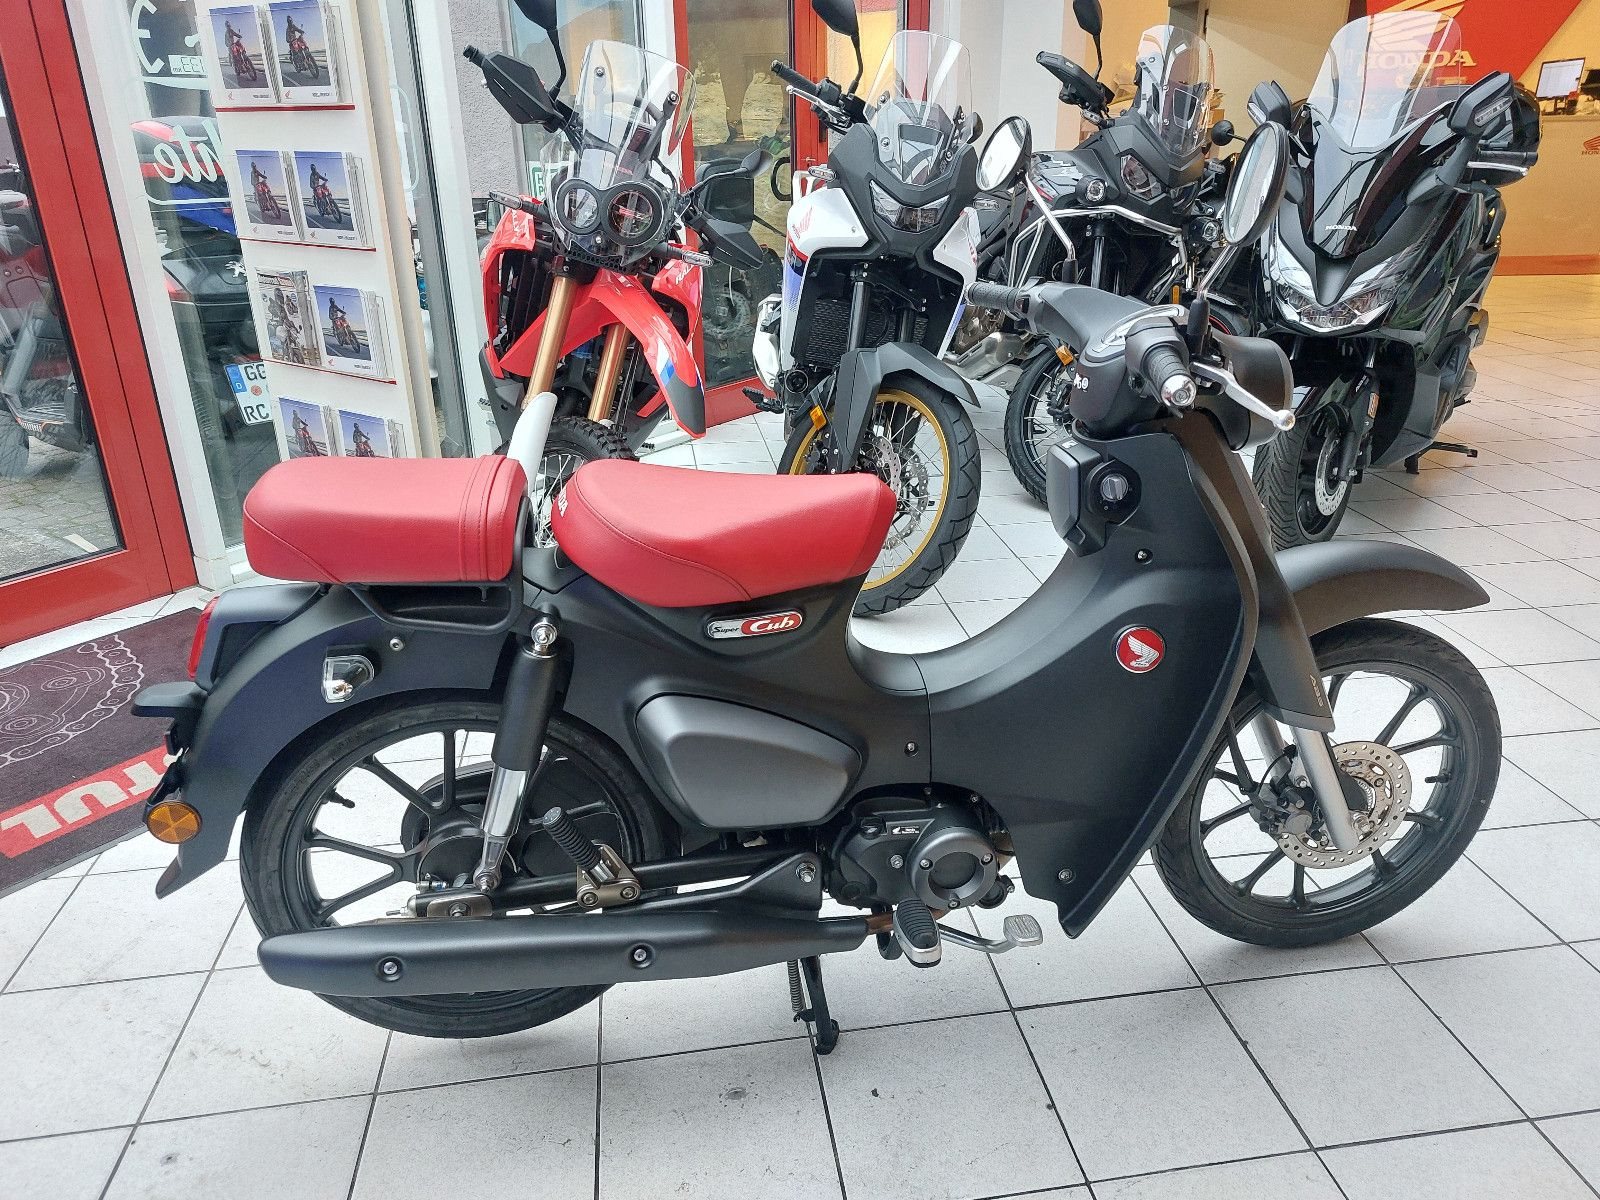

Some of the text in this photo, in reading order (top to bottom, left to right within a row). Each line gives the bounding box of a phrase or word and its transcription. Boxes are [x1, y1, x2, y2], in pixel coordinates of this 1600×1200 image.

[243, 403, 270, 421] RC
[713, 615, 795, 634] Super Cub
[0, 747, 182, 838] TUL
